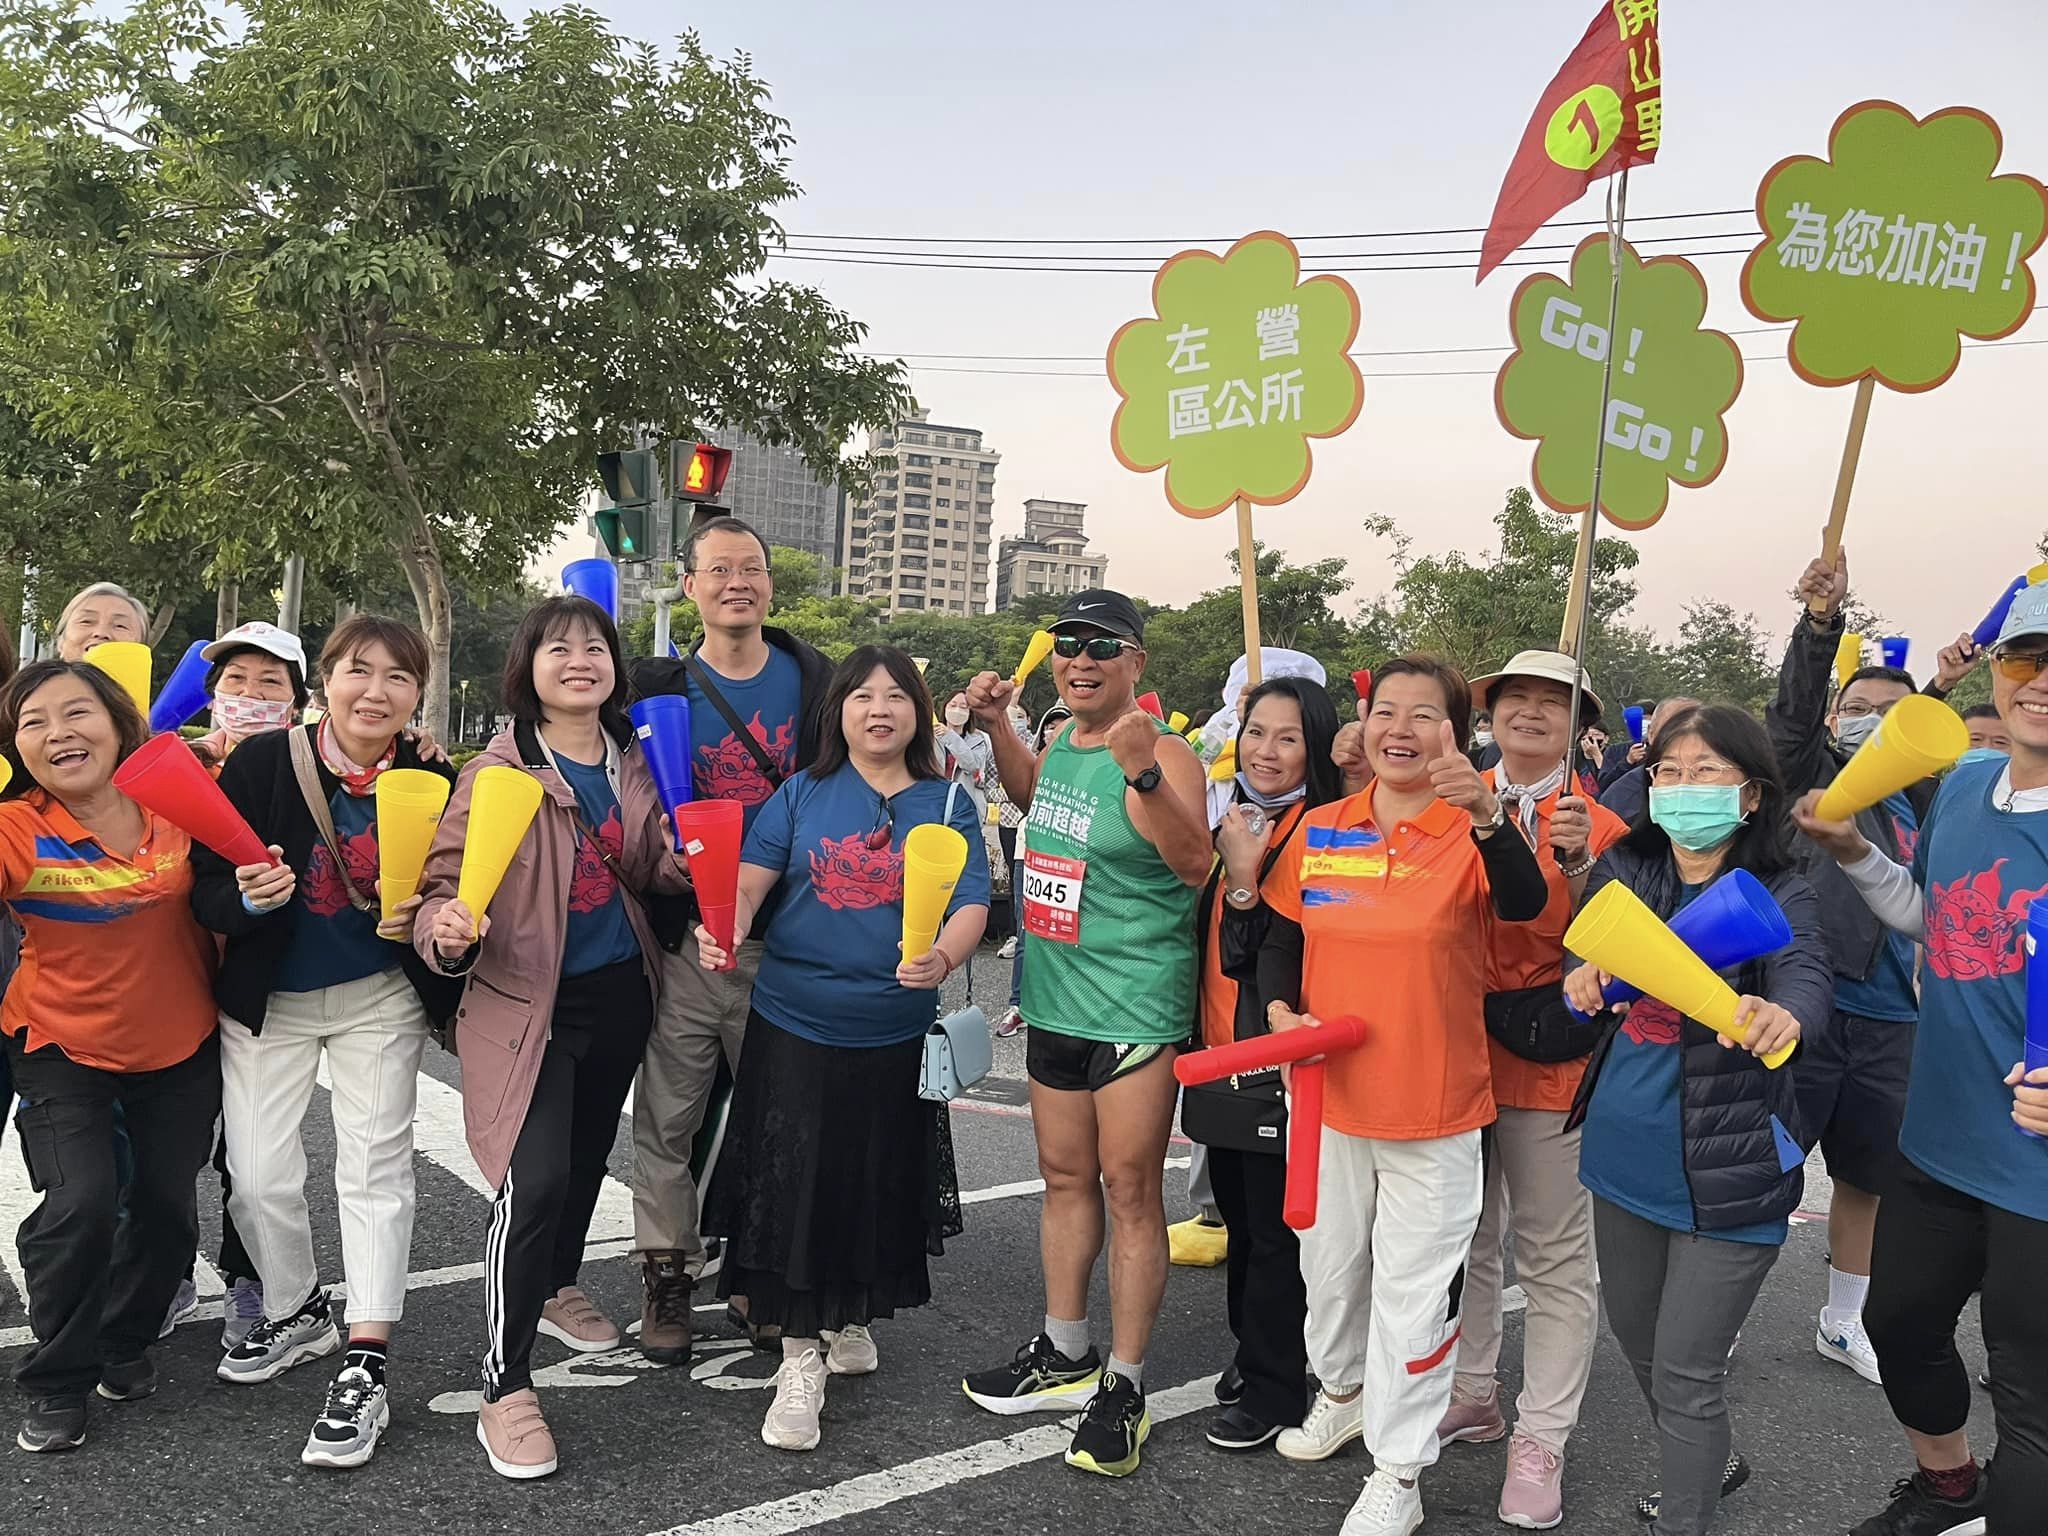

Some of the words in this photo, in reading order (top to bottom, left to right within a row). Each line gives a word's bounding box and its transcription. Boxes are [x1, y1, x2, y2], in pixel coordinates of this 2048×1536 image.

[1777, 202, 2023, 293] 為您加油！
[1167, 368, 1305, 440] 區公所
[1051, 791, 1096, 817] MARATHON
